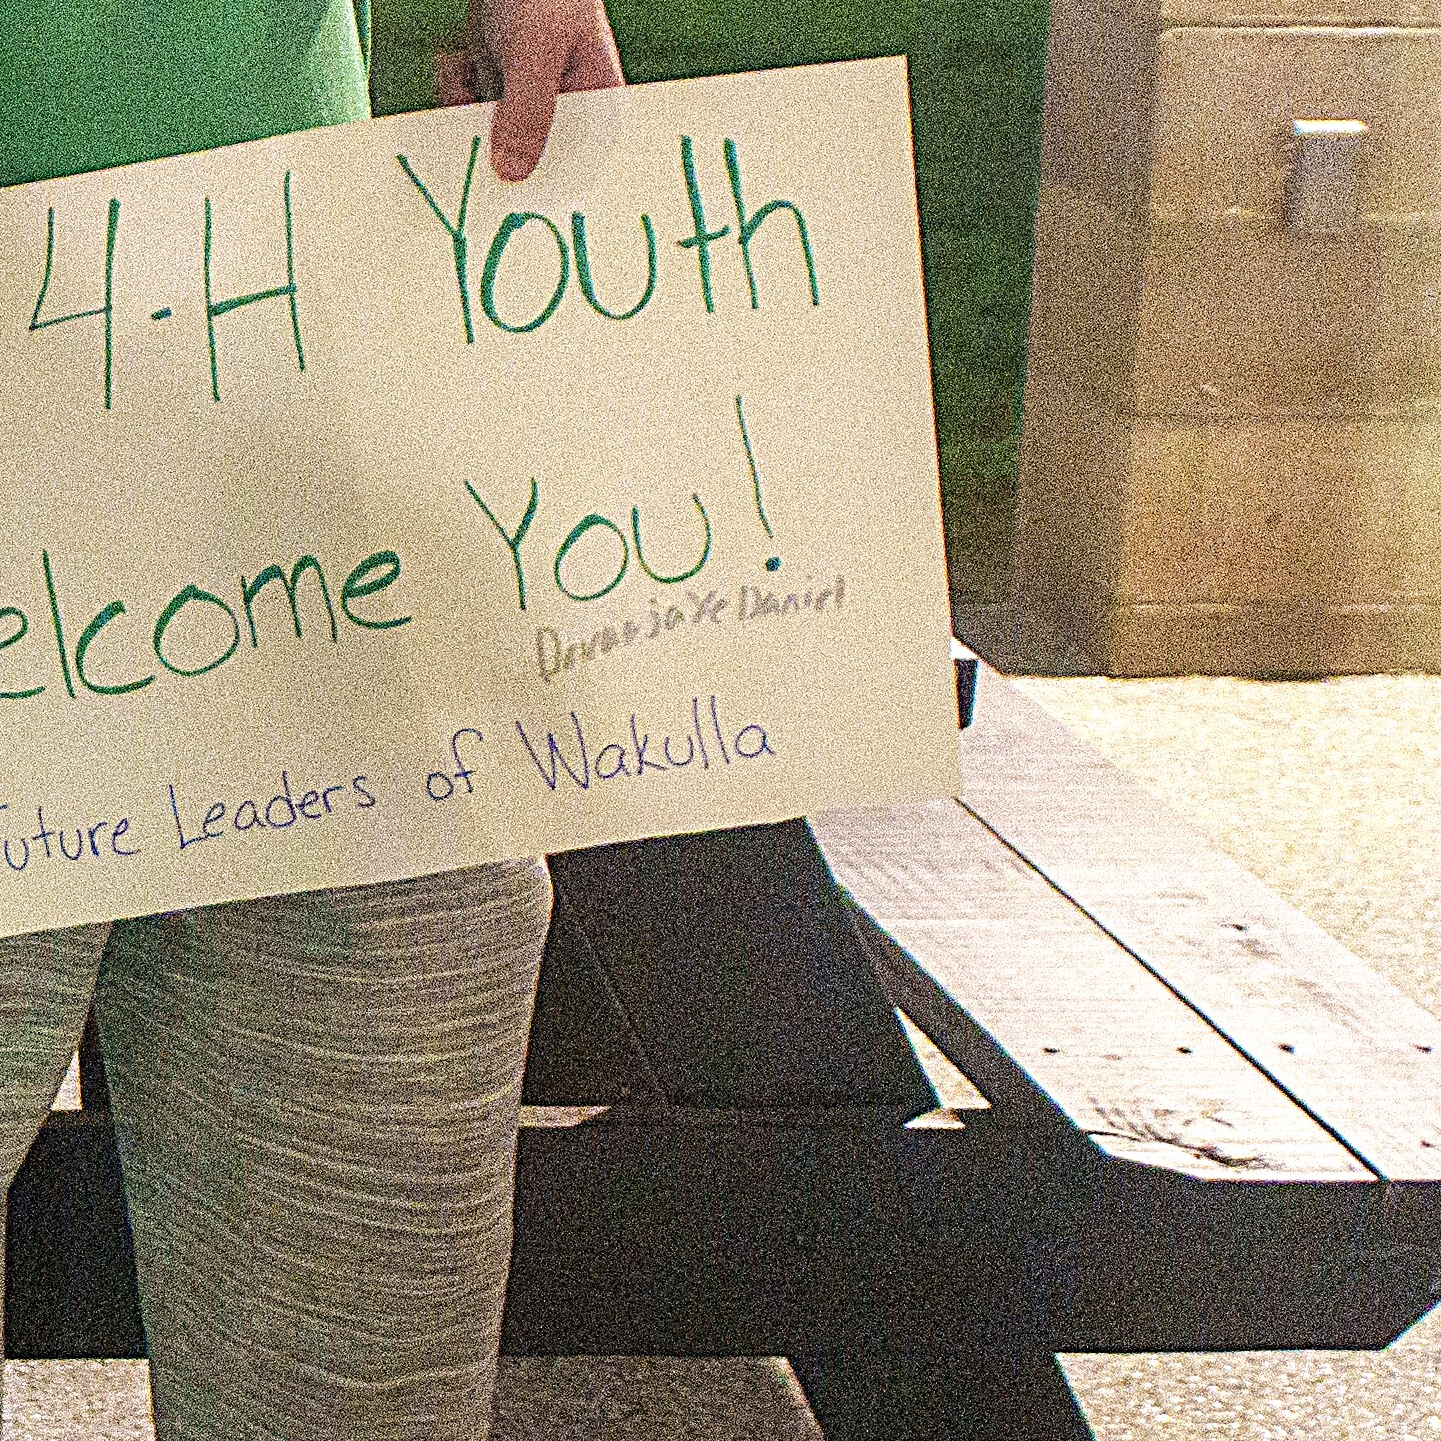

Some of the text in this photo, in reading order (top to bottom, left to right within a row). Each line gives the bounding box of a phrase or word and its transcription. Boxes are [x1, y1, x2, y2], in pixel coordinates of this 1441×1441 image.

[29, 135, 820, 410] 4-H Youth
[170, 773, 380, 852] Leaders
[423, 724, 487, 806] of
[515, 695, 775, 793] Wakulla
